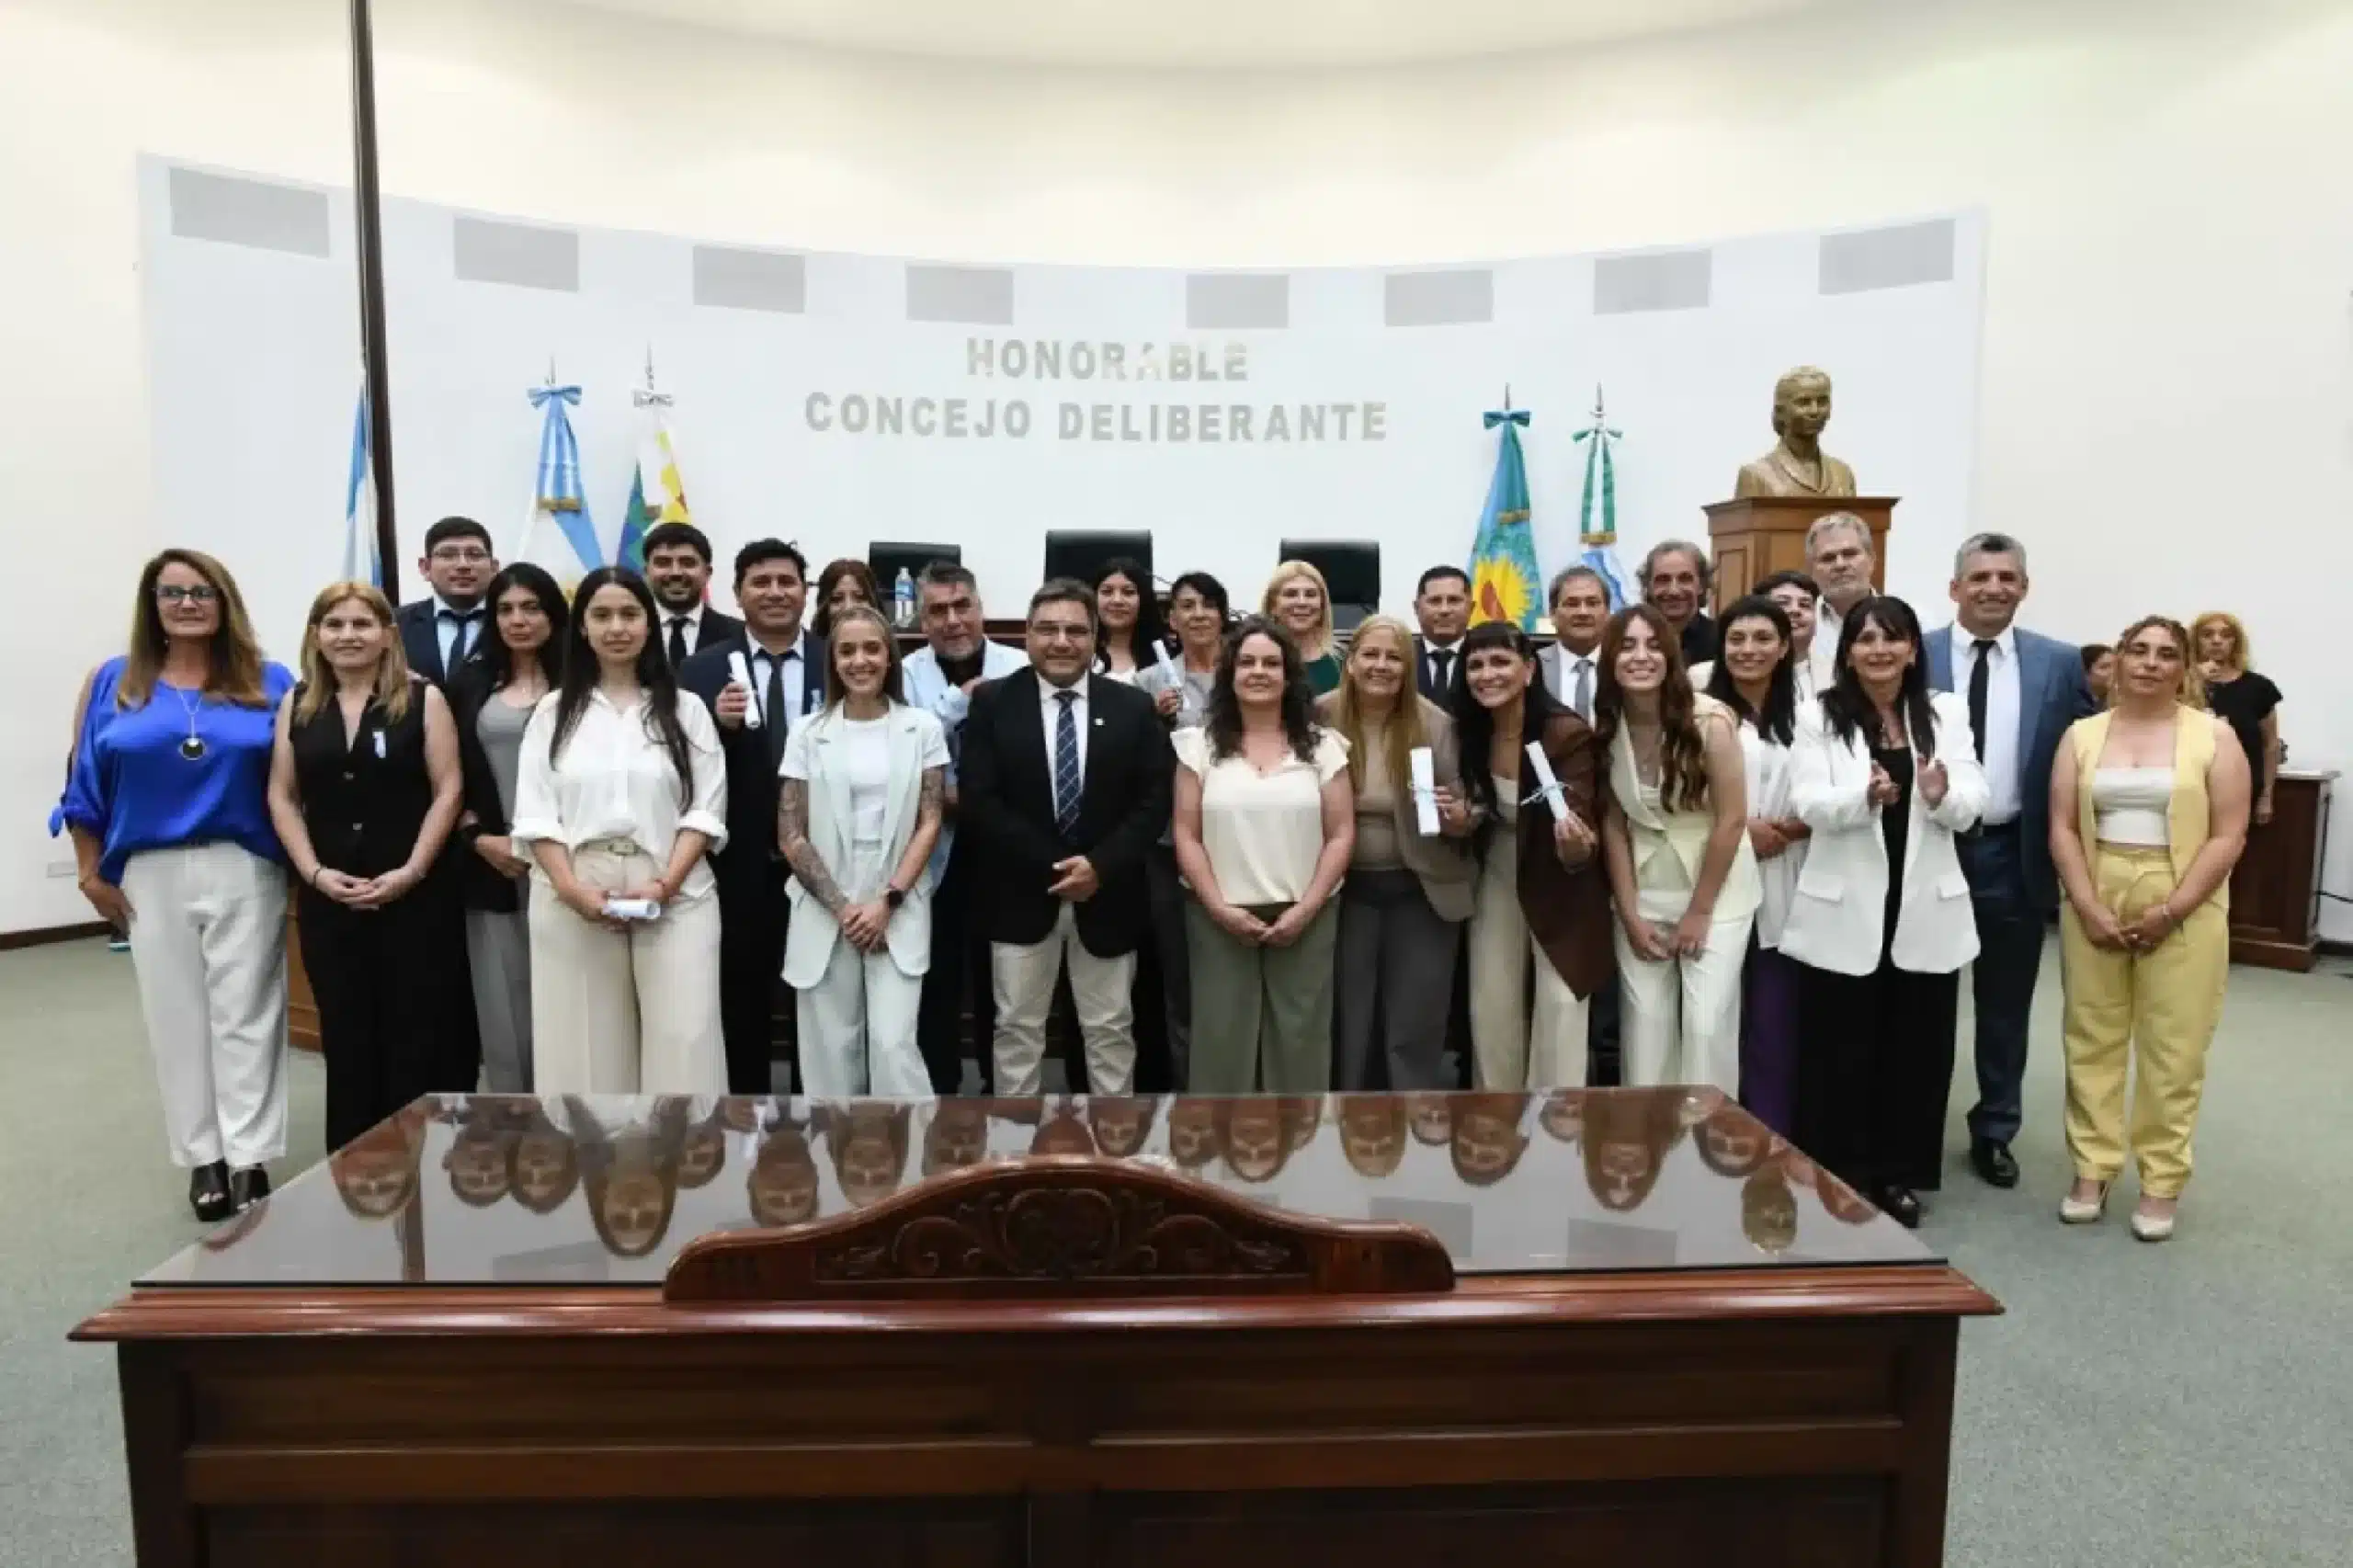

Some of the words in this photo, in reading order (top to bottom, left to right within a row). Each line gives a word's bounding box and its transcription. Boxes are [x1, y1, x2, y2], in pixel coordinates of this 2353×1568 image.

[966, 336, 1247, 381] HONORABLE
[805, 392, 1030, 437] CONCEJO
[1059, 401, 1387, 441] DELIBERANTE
